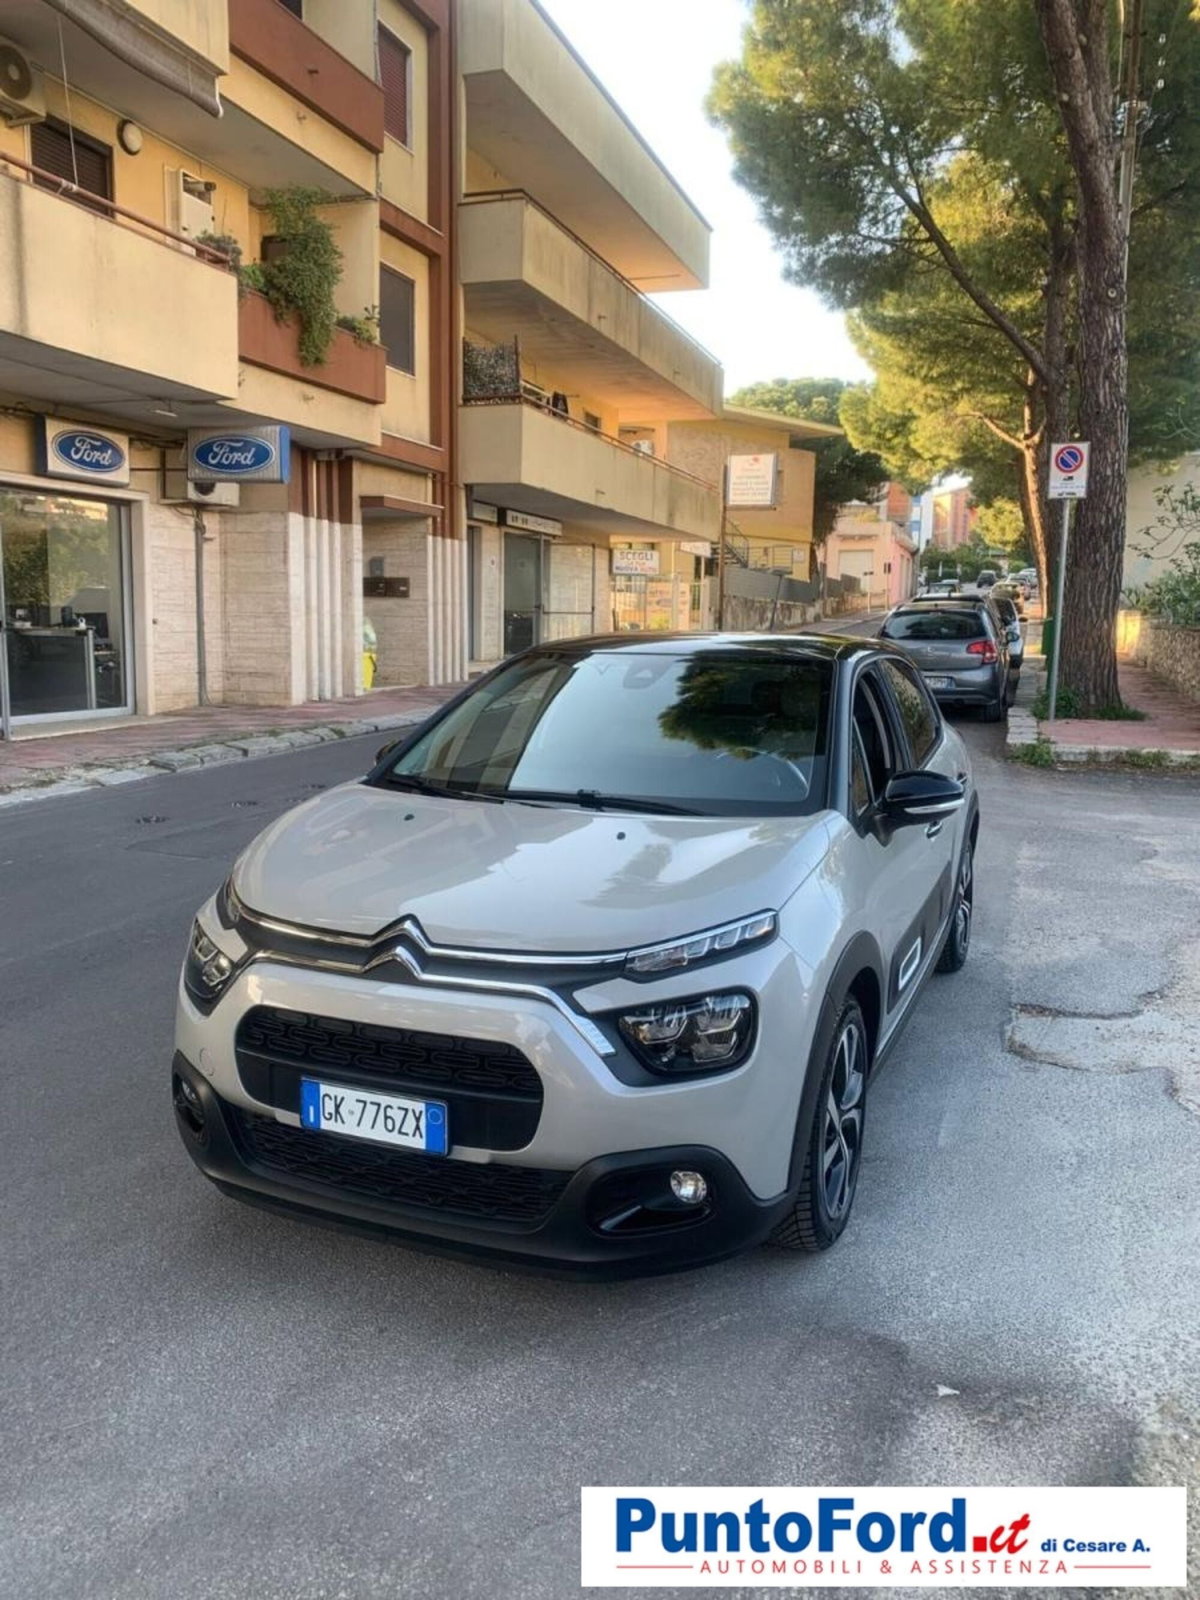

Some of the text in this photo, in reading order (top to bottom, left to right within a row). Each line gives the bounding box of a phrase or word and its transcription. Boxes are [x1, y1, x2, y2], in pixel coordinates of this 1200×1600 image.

[70, 435, 112, 466] Ford
[207, 441, 255, 466] Ford
[619, 551, 653, 560] SCEGLI
